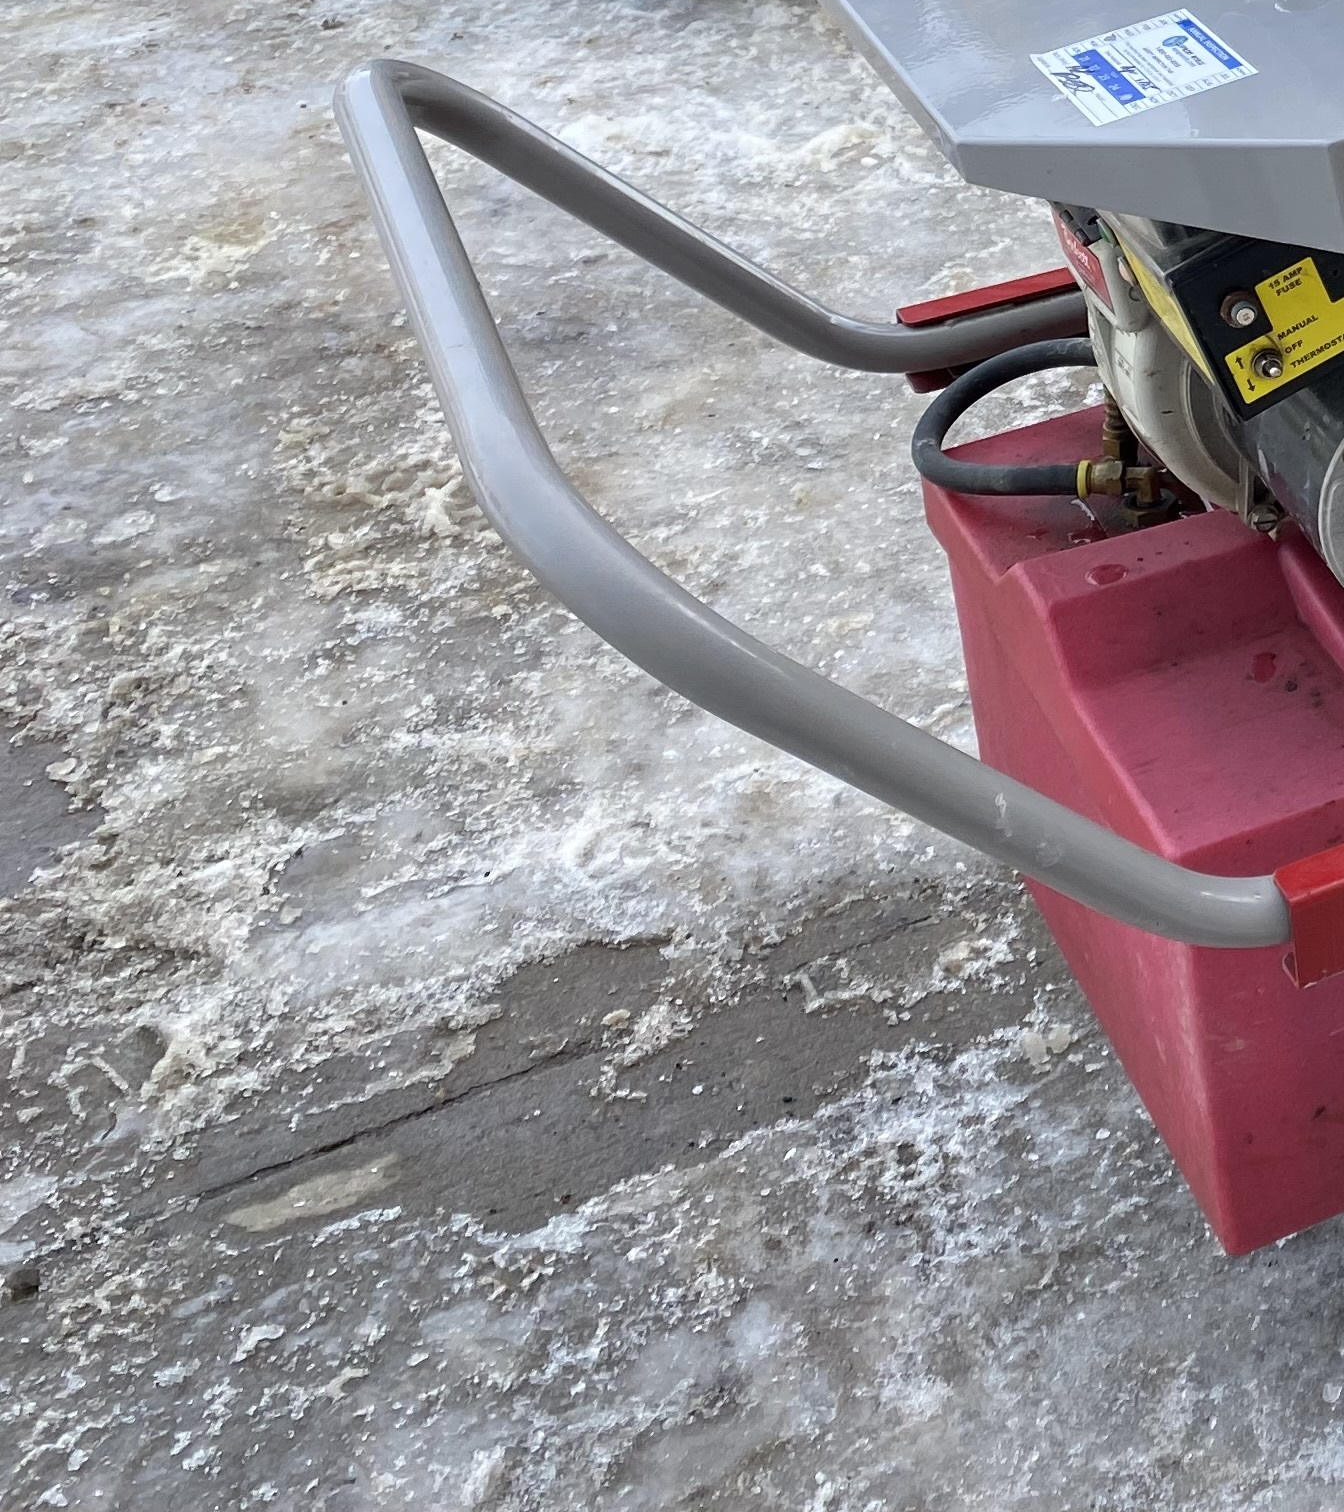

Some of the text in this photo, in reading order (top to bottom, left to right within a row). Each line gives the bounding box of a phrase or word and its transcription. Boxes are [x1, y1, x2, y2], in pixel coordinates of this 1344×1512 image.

[1282, 266, 1303, 283] AMP
[1275, 277, 1302, 296] FUSE
[1276, 314, 1318, 341] MANUAL
[1283, 339, 1303, 354] OFF
